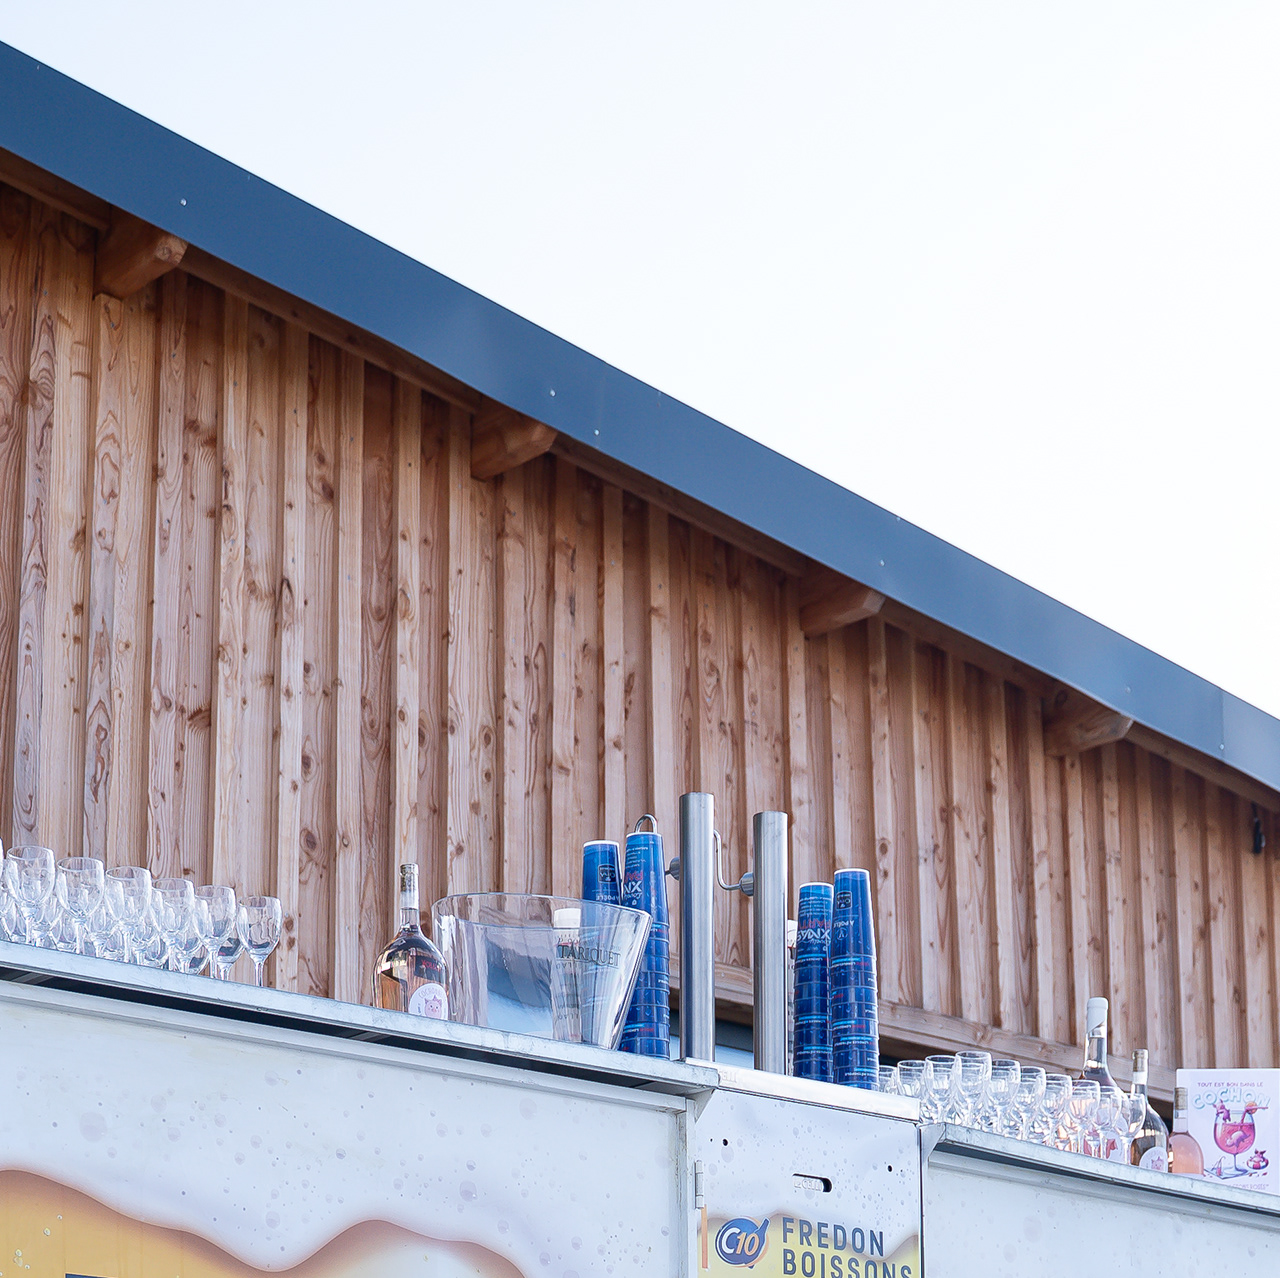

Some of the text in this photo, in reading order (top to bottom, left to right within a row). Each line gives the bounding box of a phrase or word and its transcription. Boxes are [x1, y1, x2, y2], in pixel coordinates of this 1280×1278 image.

[557, 942, 621, 966] TARIQUET
[1192, 1088, 1271, 1110] COCHON
[722, 1217, 885, 1258] C10 FREDON
